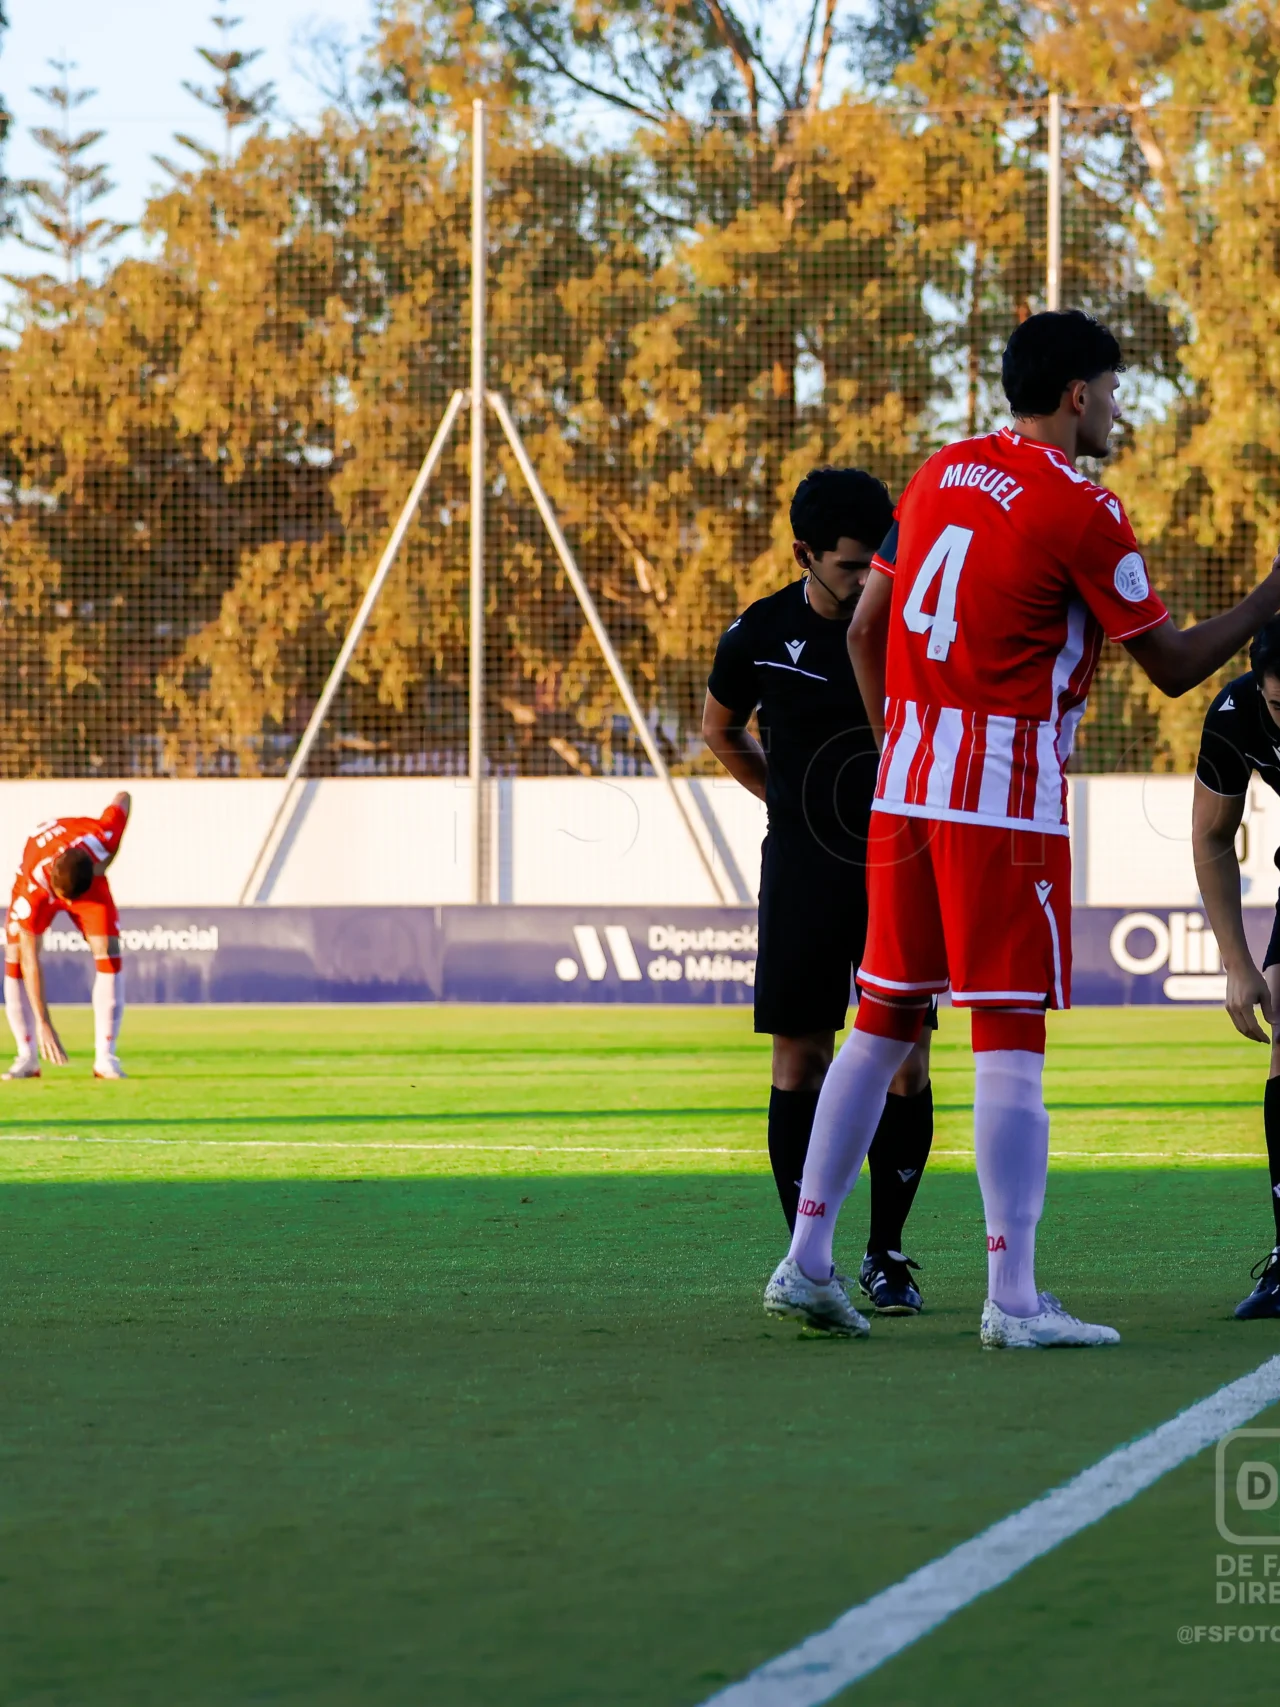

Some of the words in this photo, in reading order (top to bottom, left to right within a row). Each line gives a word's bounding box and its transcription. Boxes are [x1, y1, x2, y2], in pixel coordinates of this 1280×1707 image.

[939, 463, 1024, 512] MIGUEL
[902, 524, 974, 662] 4
[118, 924, 218, 952] rovincial
[648, 924, 759, 956] Diputació
[647, 954, 682, 981] de
[685, 954, 757, 987] Málag
[986, 1234, 1007, 1252] DA
